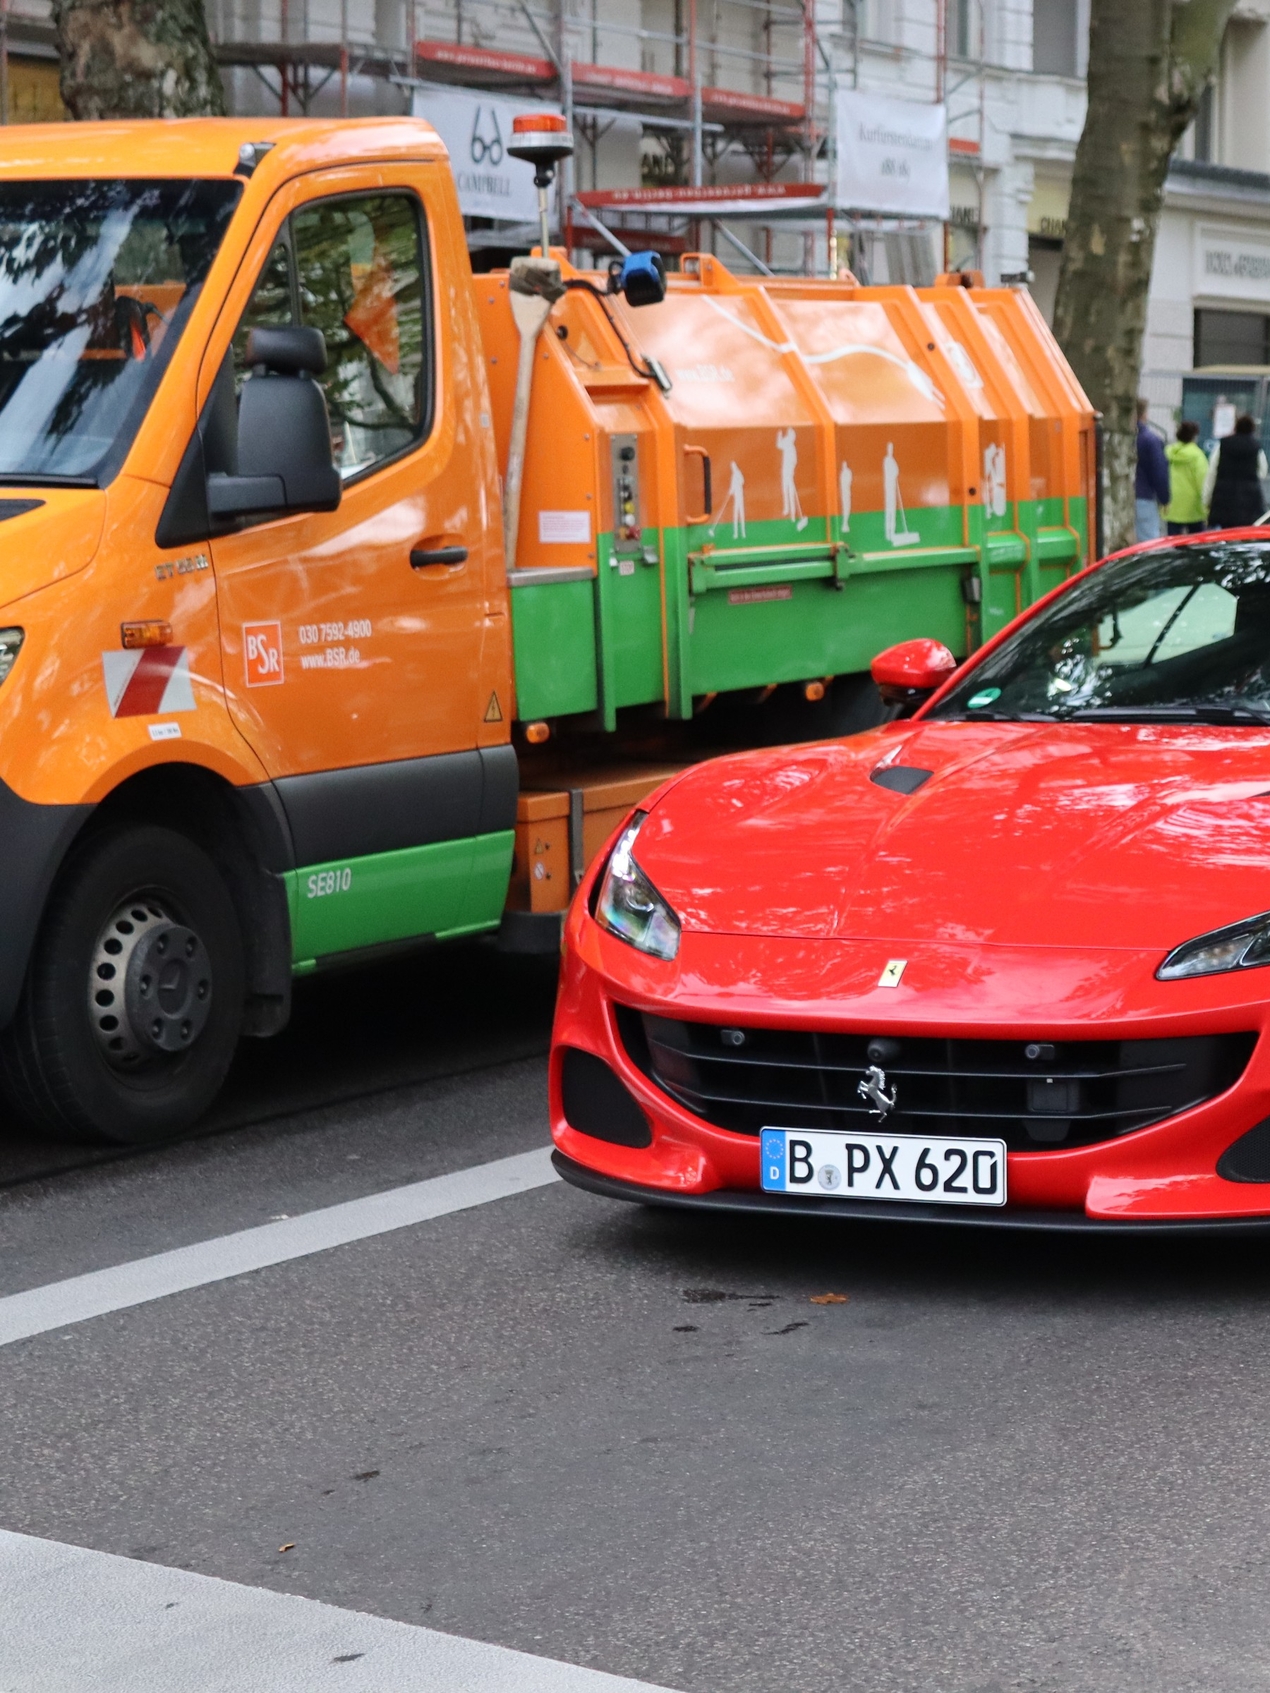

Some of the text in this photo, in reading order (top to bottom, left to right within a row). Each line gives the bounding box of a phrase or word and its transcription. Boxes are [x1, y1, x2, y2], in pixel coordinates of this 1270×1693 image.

[299, 619, 372, 644] 030 7592-4900
[247, 633, 280, 674] BSR
[301, 646, 361, 669] www.BSR.de
[307, 867, 352, 899] SE810
[770, 1166, 780, 1180] D
[789, 1139, 998, 1195] B PX 620
